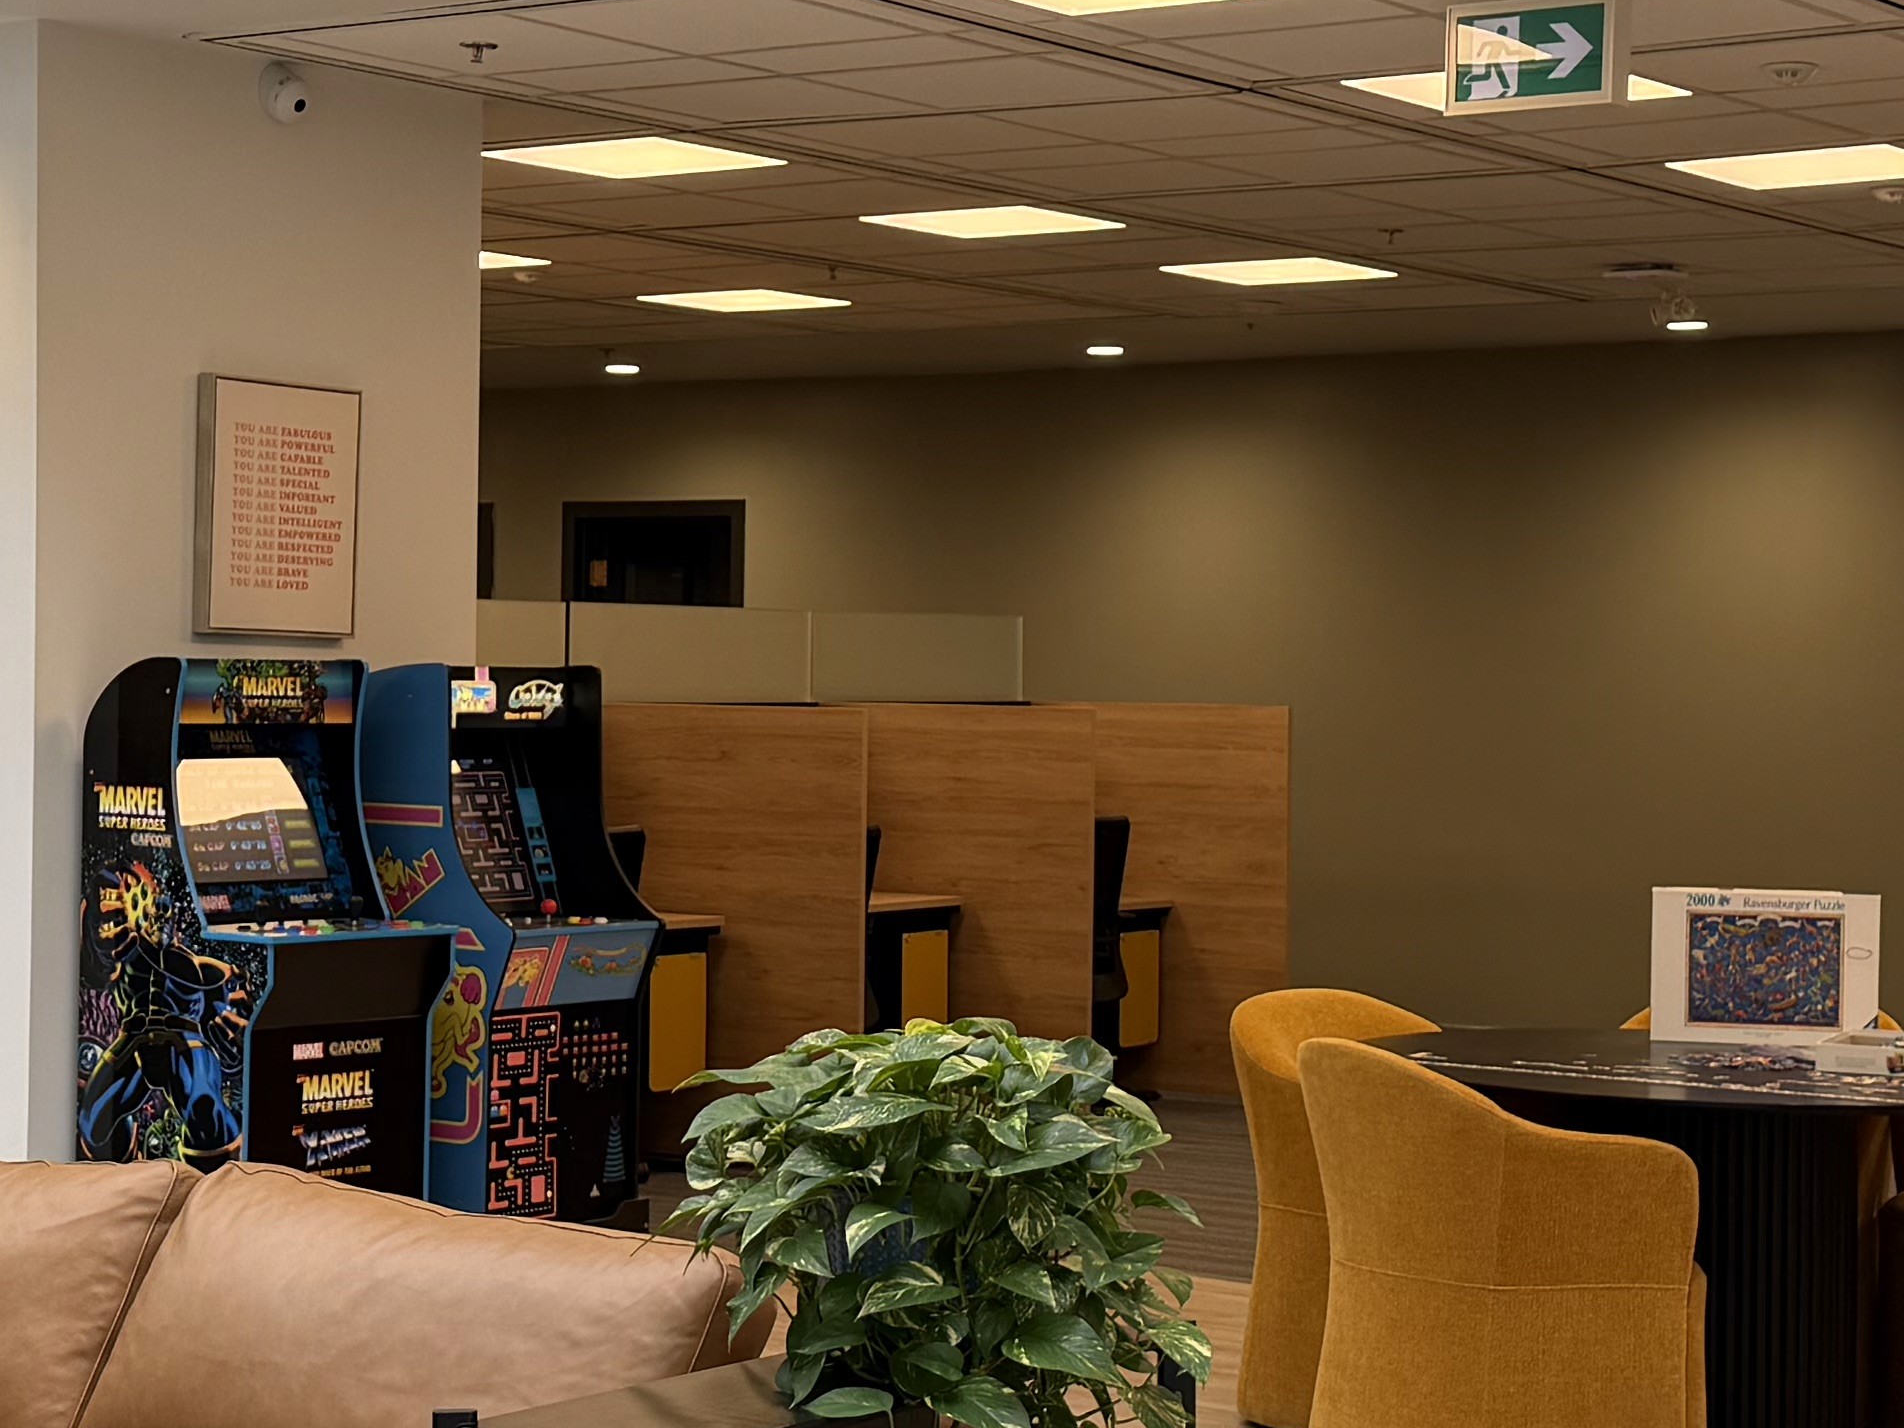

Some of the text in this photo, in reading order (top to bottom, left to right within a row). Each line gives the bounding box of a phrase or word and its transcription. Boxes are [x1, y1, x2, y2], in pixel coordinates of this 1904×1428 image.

[234, 423, 332, 440] YOU ARE FABULOUS
[234, 436, 335, 454] YOU ARE POWERFUL
[234, 449, 324, 465] YOU ARE CAPABLE
[233, 462, 330, 478] YOU ARE TALENTED
[233, 474, 320, 490] YOU ARE SPECIAL
[233, 487, 336, 504] YOU ARE IMPORTANT
[233, 500, 317, 515] YOU ARE VALUED
[232, 513, 342, 530] YOU ARE INTELLIGENT
[232, 526, 341, 542] YOU ARE EMPOWERED
[231, 539, 333, 554] YOU ARE RESPECTED
[231, 552, 333, 566] YOU ARE DESERVING
[230, 564, 309, 578] YOU ARE BRAVE
[230, 577, 309, 590] YOU ARE LOVED
[242, 675, 303, 696] MARVEL
[99, 785, 166, 817] MARVEL
[99, 815, 166, 831] SUPER HEROES
[130, 832, 173, 848] CAPCOM
[1686, 894, 1845, 911] 2000 Ravensburger Puzzle
[329, 1039, 382, 1056] CAPCOM
[302, 1071, 373, 1101] MARVEL
[302, 1097, 373, 1114] SUPER HEROES
